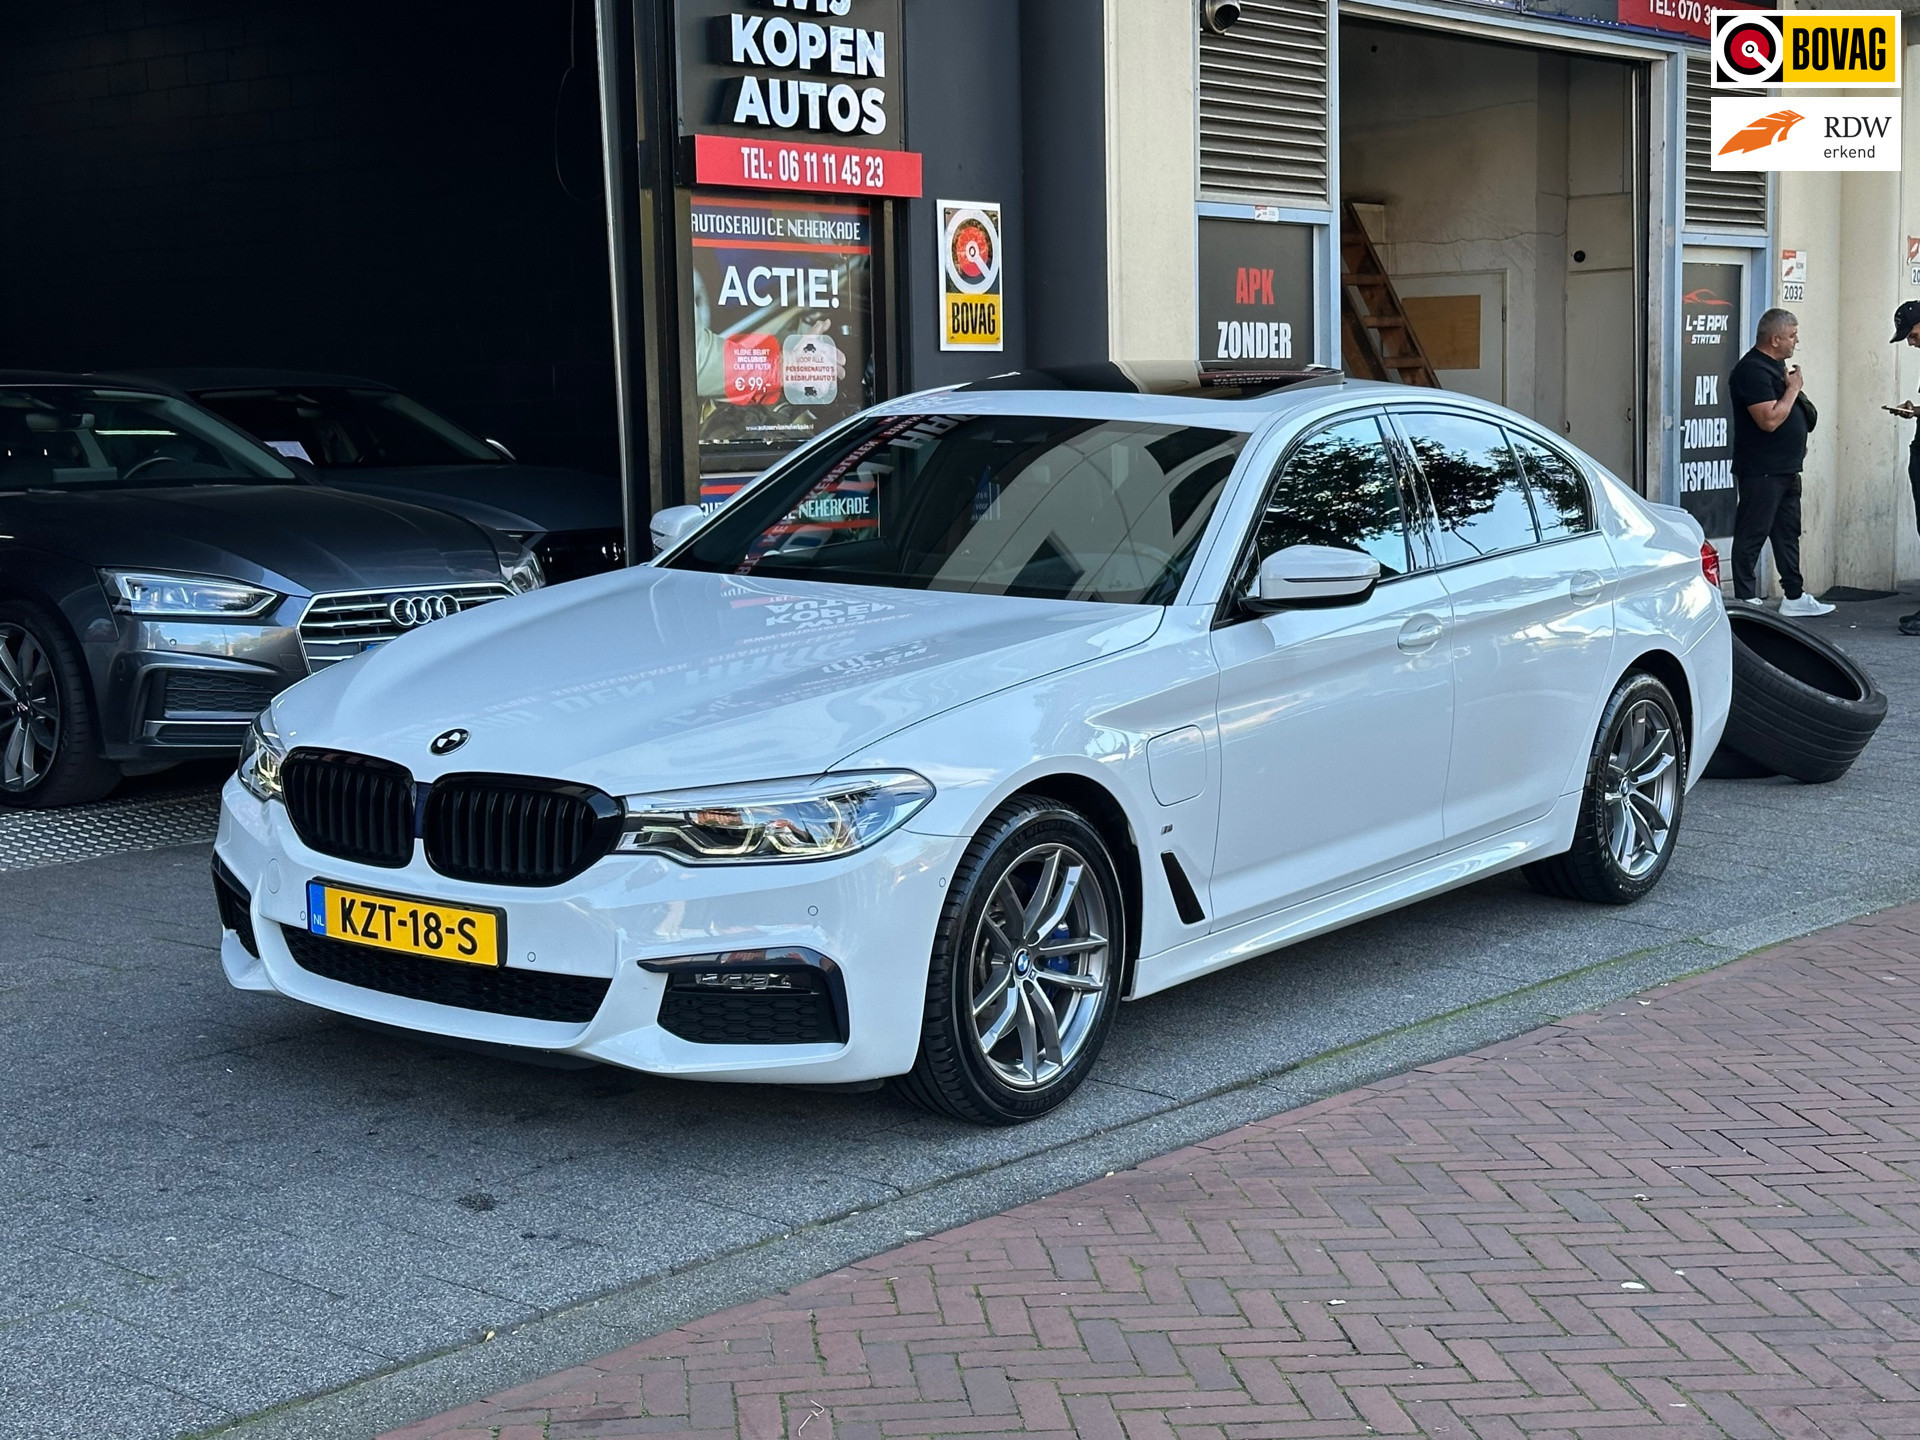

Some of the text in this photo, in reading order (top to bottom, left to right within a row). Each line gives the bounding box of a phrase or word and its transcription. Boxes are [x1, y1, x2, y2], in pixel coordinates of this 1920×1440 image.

[1649, 0, 1676, 17] TEL:
[1678, 0, 1701, 23] 070
[731, 13, 885, 78] KOPEN
[733, 75, 886, 136] AUTOS
[741, 147, 884, 188] TEL: 06 11 11 45 23
[691, 213, 861, 240] AUTOSERVICE NEHERKADE
[718, 266, 840, 309] ACTIE!
[1235, 267, 1274, 305] APK
[1784, 285, 1803, 300] 2032
[952, 302, 996, 336] BOVAG
[1685, 314, 1729, 331] L-E APK
[1217, 321, 1292, 359] ZONDER
[1691, 334, 1721, 344] STATION
[734, 377, 746, 391] €
[1694, 375, 1719, 405] APK
[1684, 418, 1728, 449] ZONDER
[798, 496, 870, 518] NEHERKADE
[313, 913, 325, 927] NL
[341, 897, 478, 956] KZT-18-S
